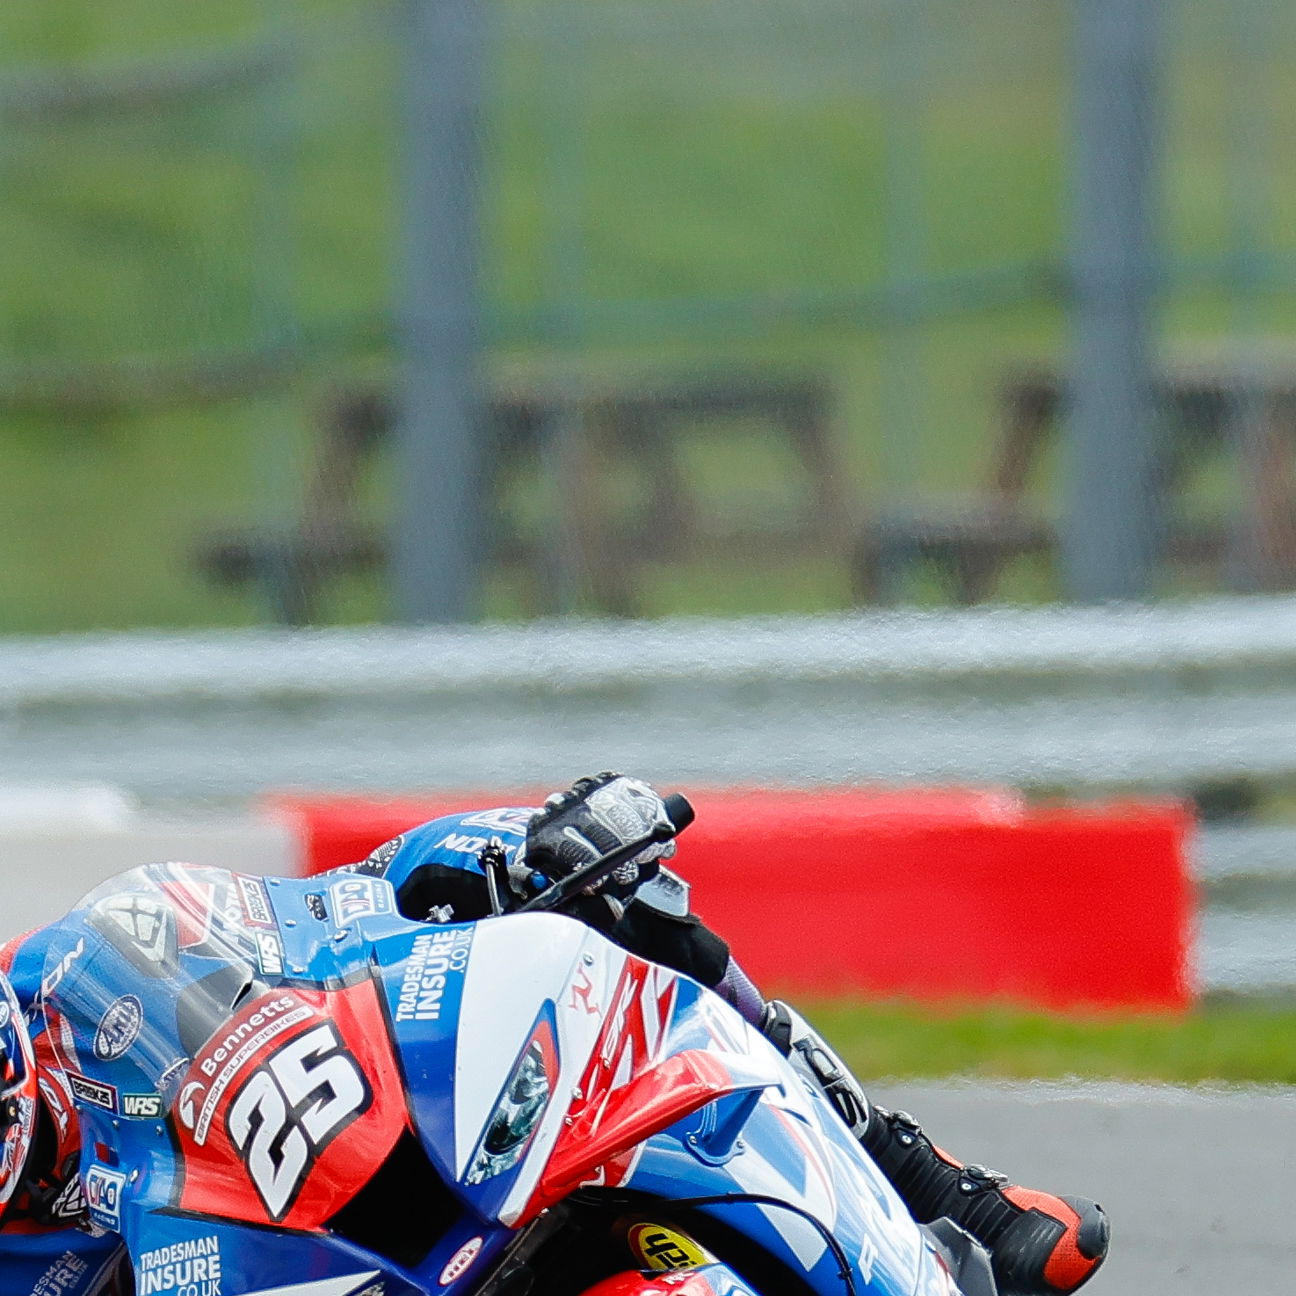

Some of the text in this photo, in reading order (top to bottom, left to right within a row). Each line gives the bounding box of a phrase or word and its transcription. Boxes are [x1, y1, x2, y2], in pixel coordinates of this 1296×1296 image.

[257, 932, 284, 974] WRS
[396, 934, 433, 1022] TRADESMAN
[415, 929, 457, 1020] INSURE
[449, 926, 474, 974] .CO.UK
[201, 996, 294, 1077] Bennetts
[124, 1096, 160, 1115] WRS
[197, 1010, 306, 1138] BRITISH SUPERBIKES
[227, 1023, 366, 1220] 25
[140, 1235, 218, 1272] TRADESMAN
[140, 1255, 222, 1296] INSURE
